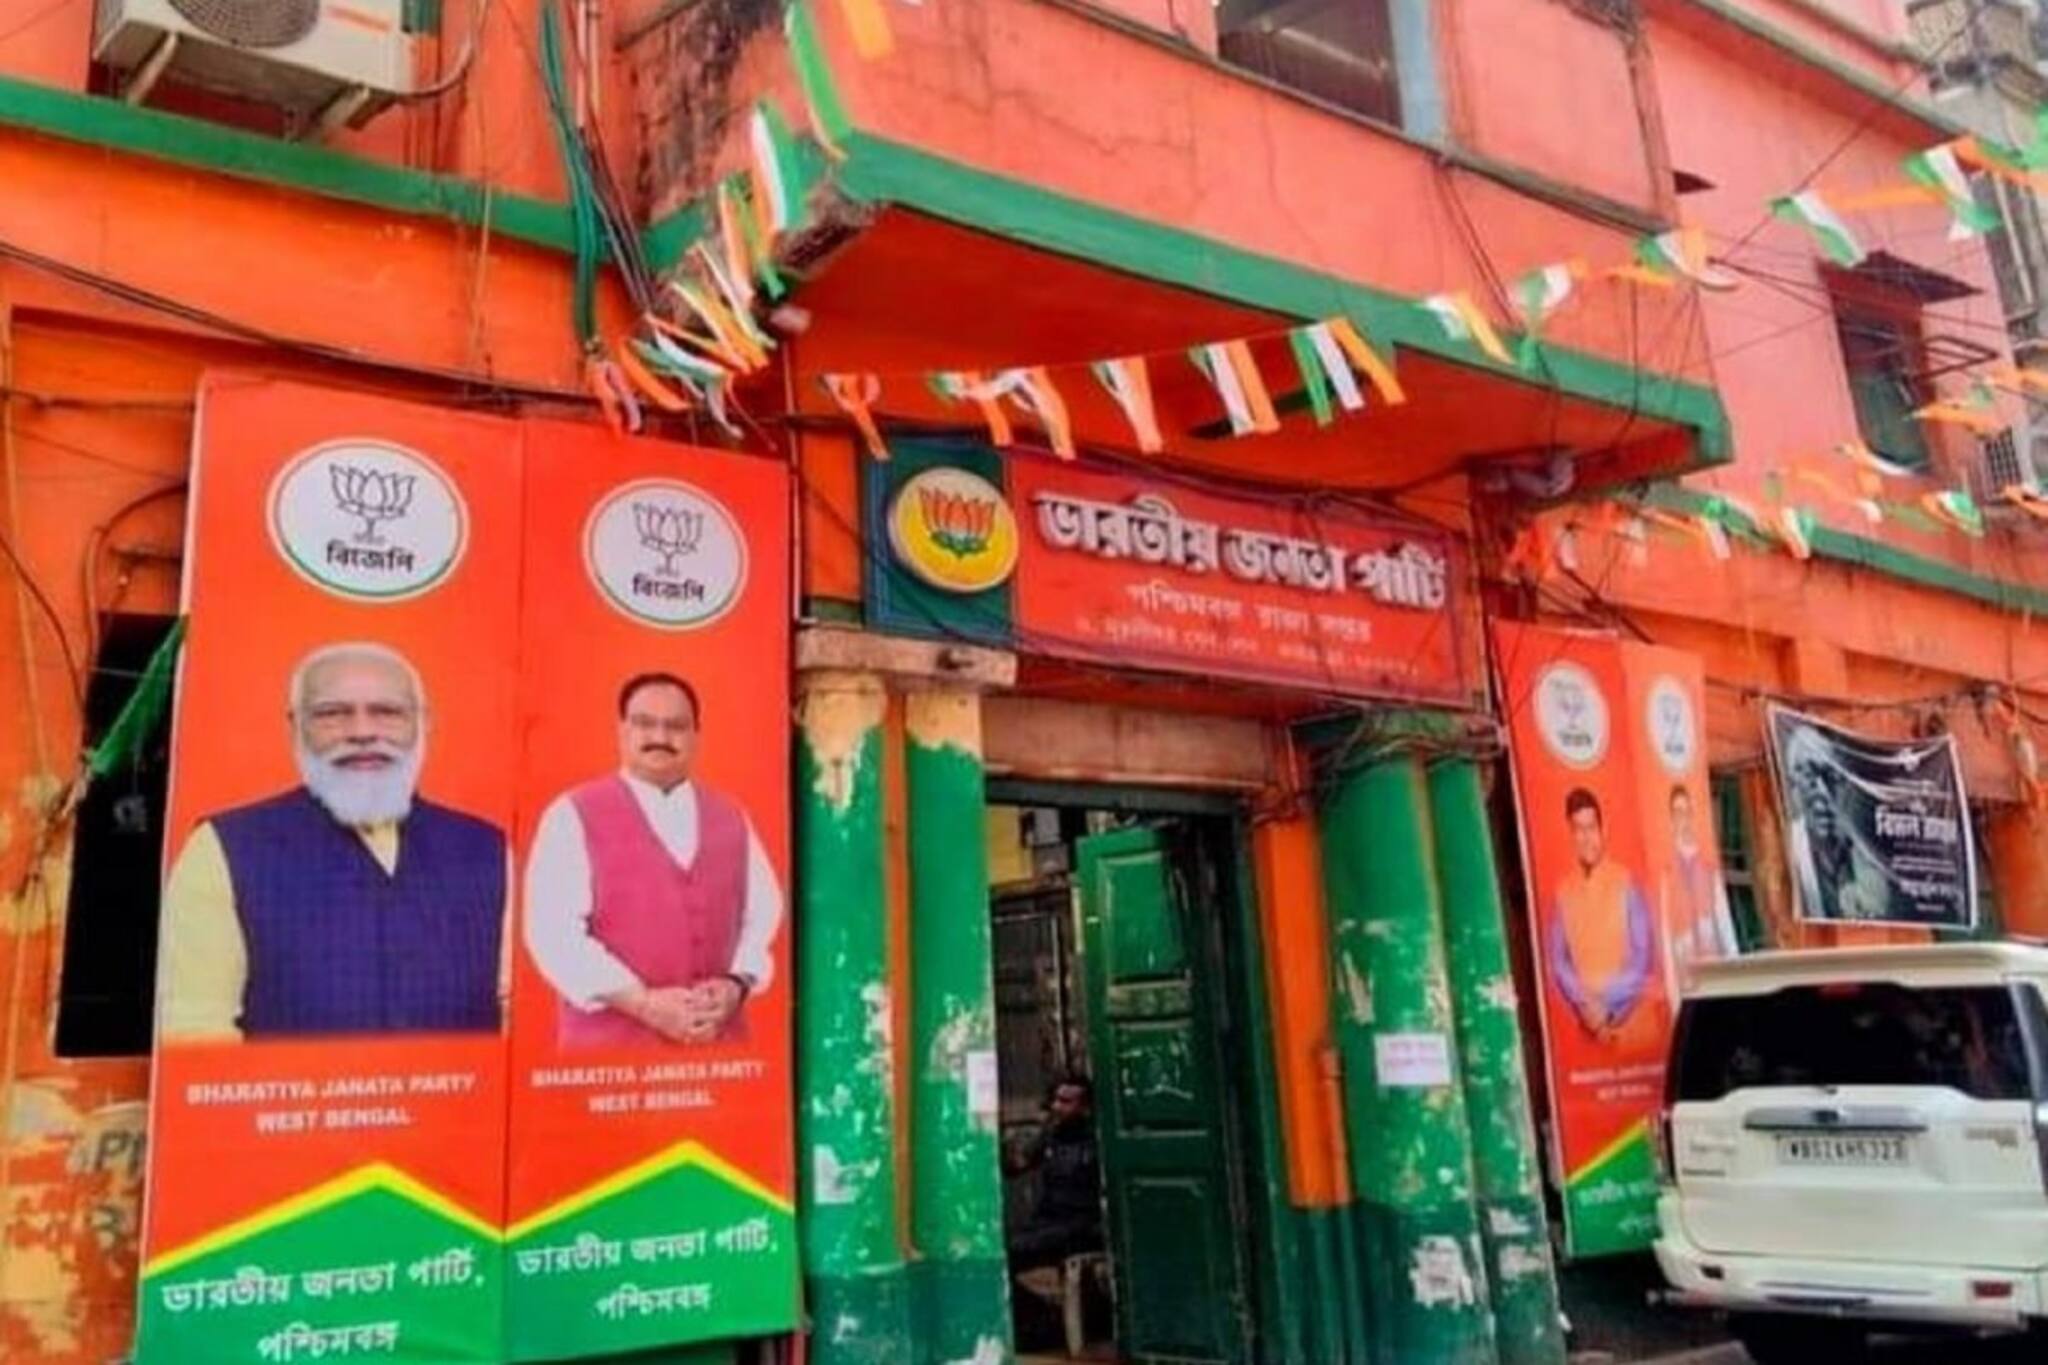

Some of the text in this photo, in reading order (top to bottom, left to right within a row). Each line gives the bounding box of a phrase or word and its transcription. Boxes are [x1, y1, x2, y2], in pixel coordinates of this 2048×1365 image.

[326, 539, 414, 573] বিজেপি
[1035, 491, 1447, 607] ভারতীয় জনতা পার্টি
[185, 1071, 477, 1106] BHARATIYA JANATA PARTY
[255, 1105, 412, 1133] WEST BENGAL
[515, 1232, 622, 1275] ভারতীয়
[629, 1227, 708, 1264] জনতা
[161, 1264, 293, 1311] ভারতীয়
[299, 1260, 398, 1298] জনতা
